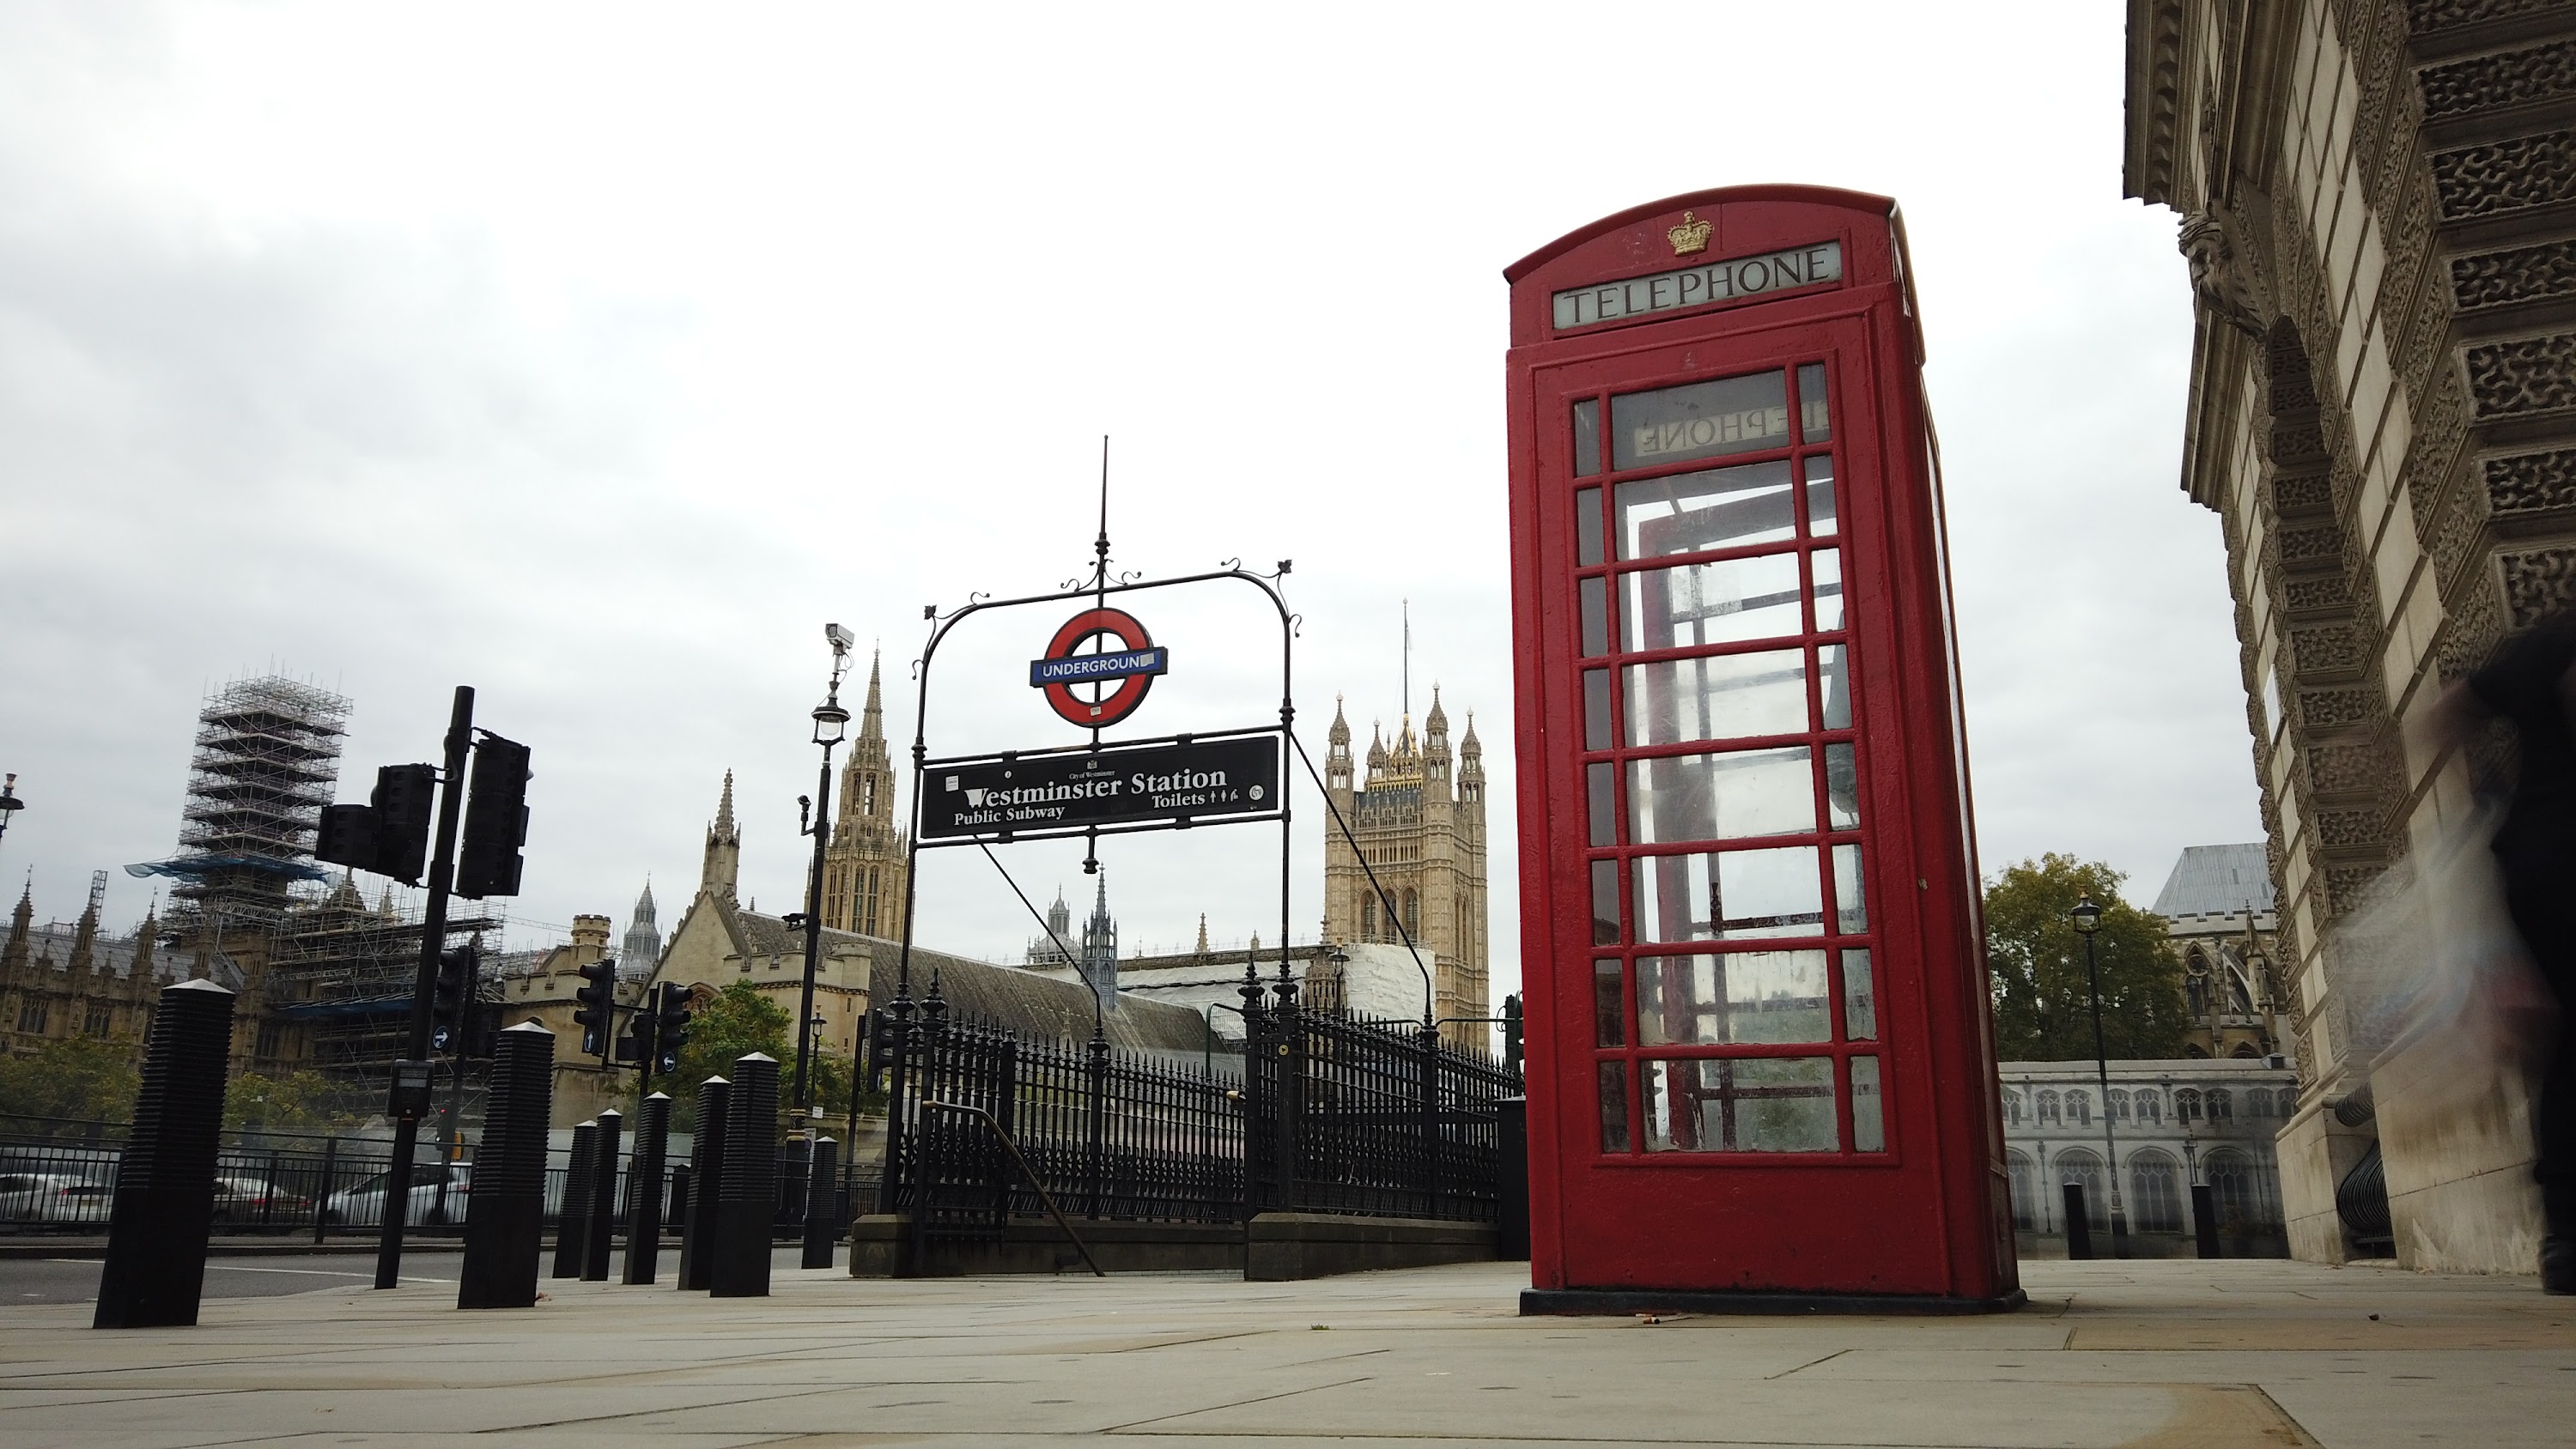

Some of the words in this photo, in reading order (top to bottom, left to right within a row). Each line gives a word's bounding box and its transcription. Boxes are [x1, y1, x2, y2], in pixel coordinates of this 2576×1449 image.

[1564, 247, 1829, 324] TELEPHONE
[1042, 656, 1149, 677] UNDERGROUN
[1131, 768, 1227, 795] Station
[1151, 792, 1206, 809] Toilets
[954, 809, 1001, 825] Public
[1005, 806, 1066, 822] Subway
